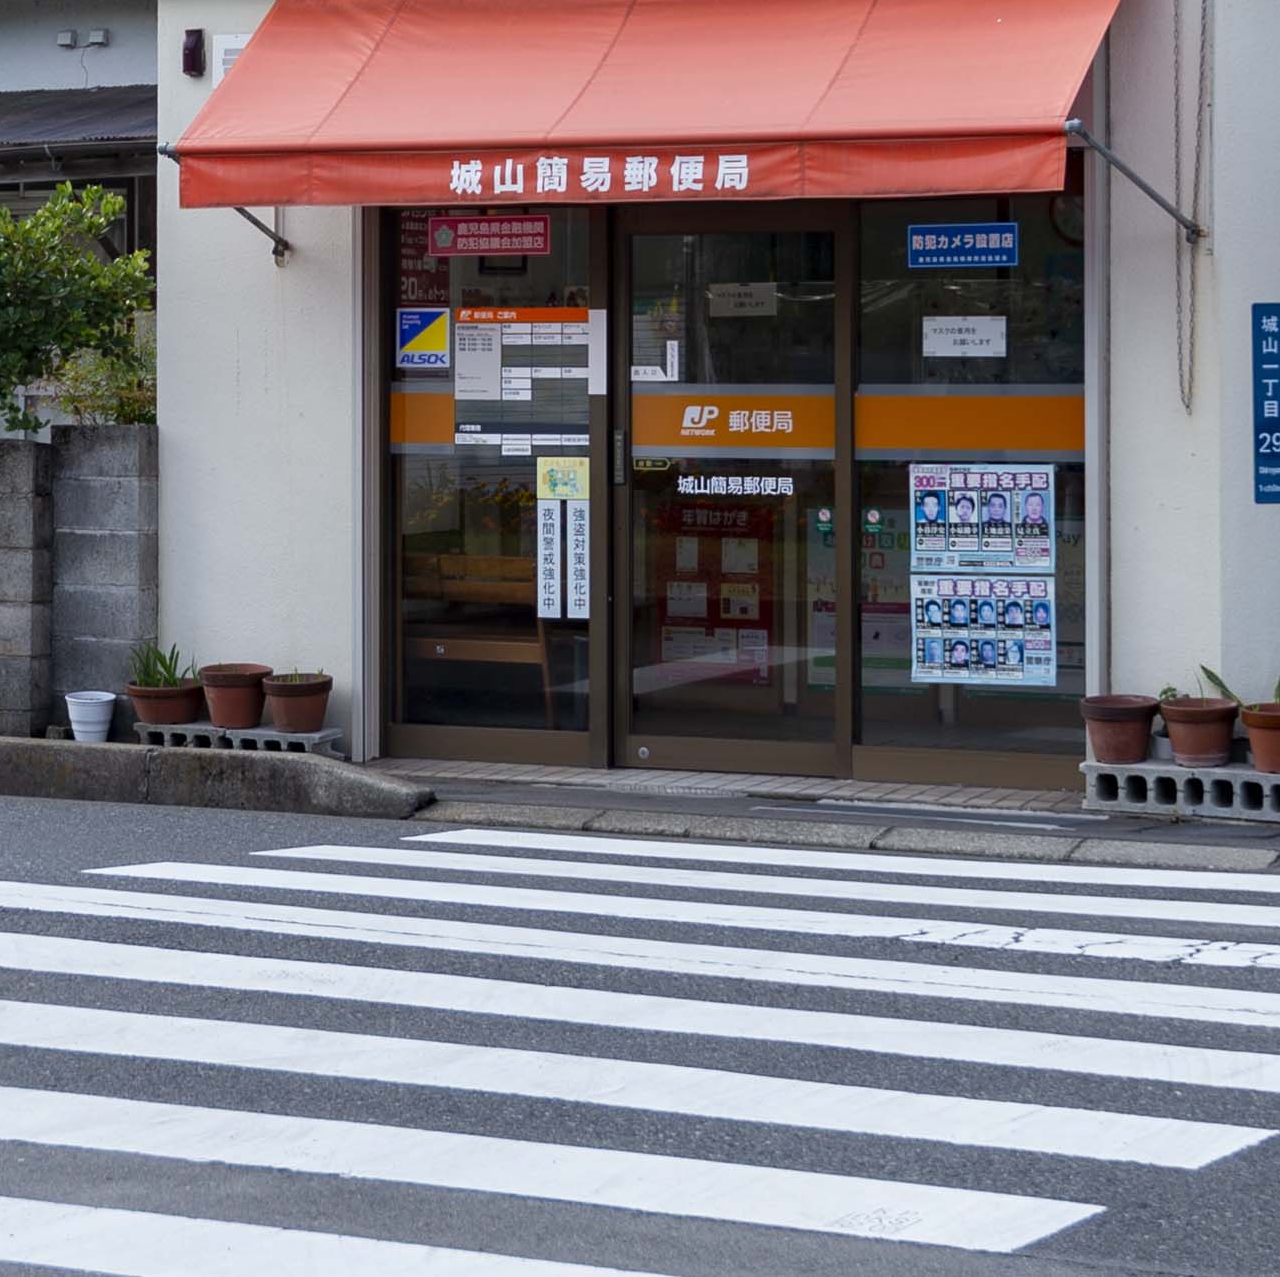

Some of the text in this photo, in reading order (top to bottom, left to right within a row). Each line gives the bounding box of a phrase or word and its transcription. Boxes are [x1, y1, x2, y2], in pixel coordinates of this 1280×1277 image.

[449, 154, 749, 195] 城山簡易郵便局
[457, 221, 545, 235] 鹿児島県金融機関
[457, 236, 545, 250] 防犯協議会加盟店
[912, 233, 1014, 250] 防犯カメラ設置店
[400, 353, 447, 365] ALSOK
[1261, 315, 1280, 418] 城山一丁目
[728, 409, 794, 434] 郵便局
[677, 475, 794, 496] 城山簡易郵便局
[948, 472, 1050, 491] 重要指名手配
[542, 507, 556, 611] 夜間警戒強化中
[573, 507, 587, 611] 強盗対策強化中
[937, 578, 1049, 598] 重要指名手配
